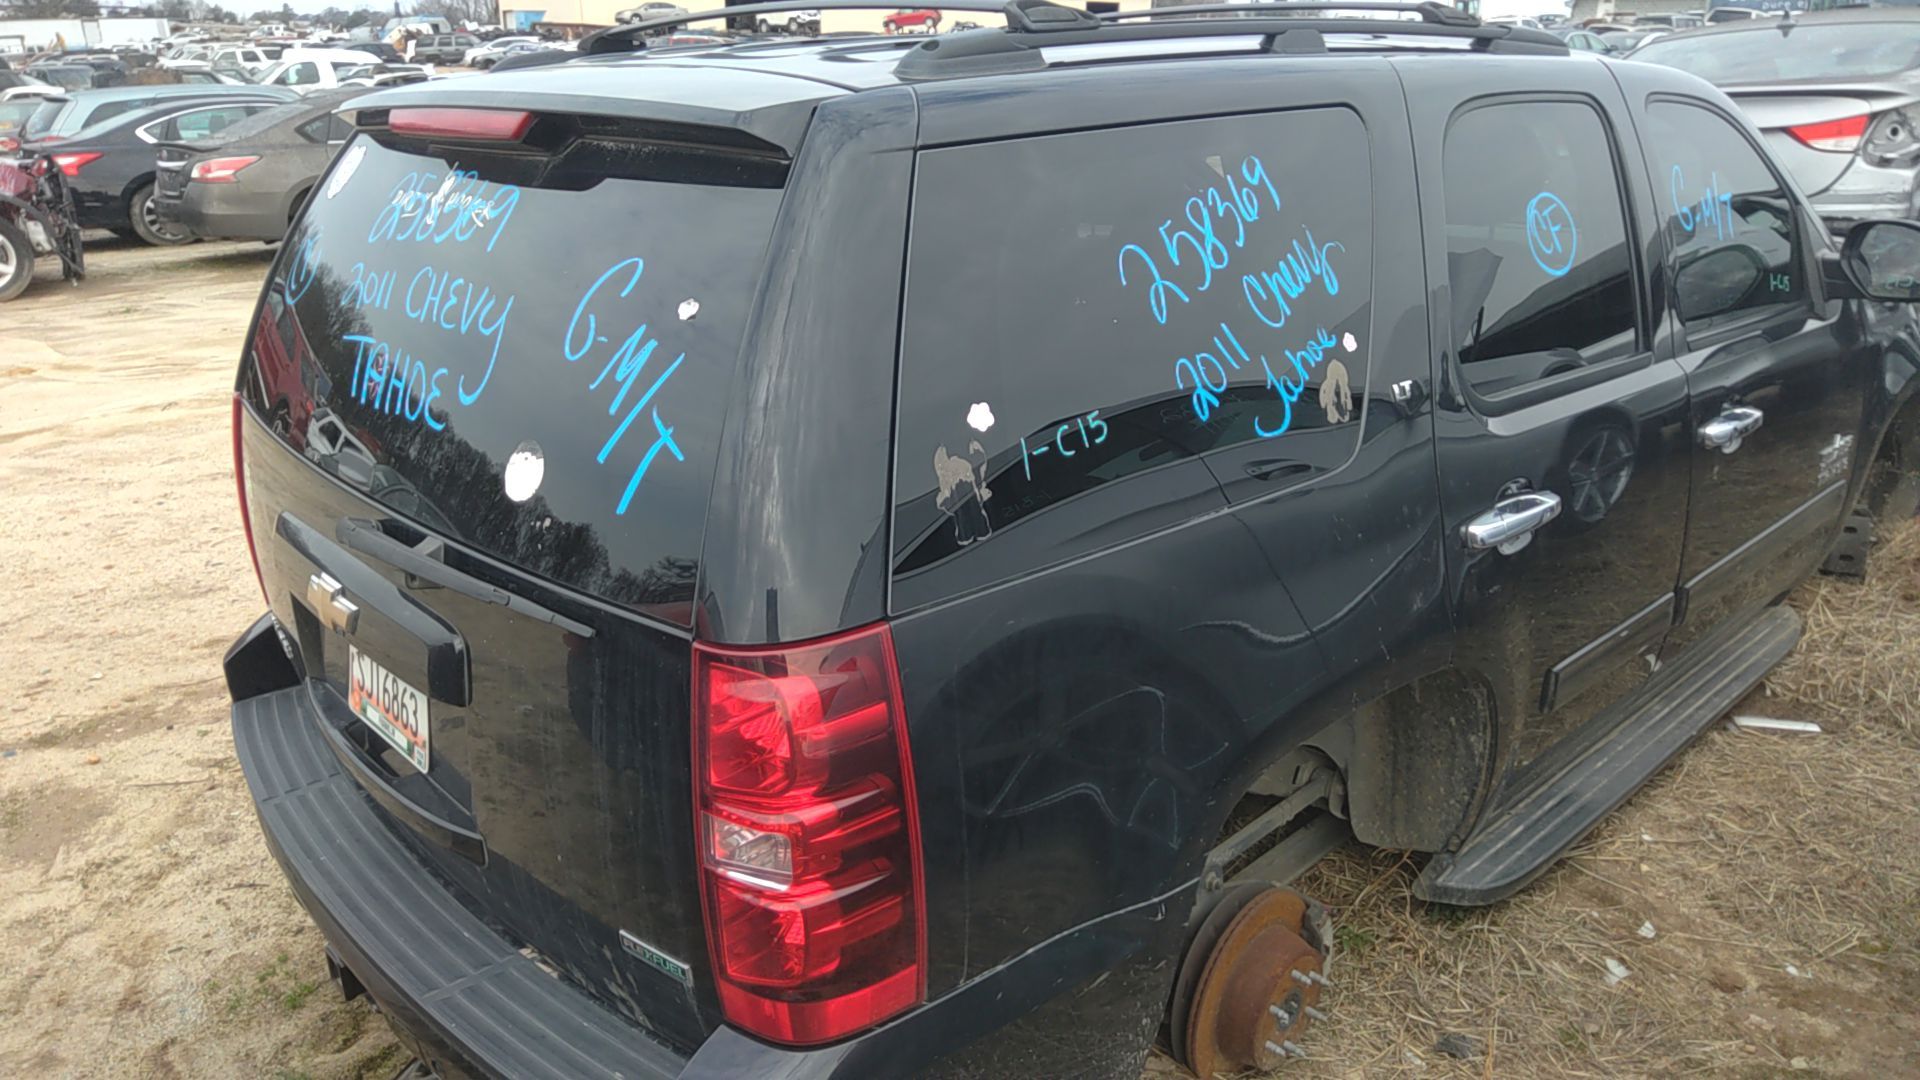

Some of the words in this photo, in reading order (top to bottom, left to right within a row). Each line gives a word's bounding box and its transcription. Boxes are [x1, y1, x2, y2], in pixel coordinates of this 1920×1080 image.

[1118, 154, 1281, 324] 258369
[340, 261, 398, 311] 2011
[404, 265, 516, 407] CHEVY
[341, 333, 449, 432] TAHOE
[1175, 321, 1251, 423] 2011
[1391, 379, 1413, 402] LT
[1019, 409, 1109, 482] 1-C15
